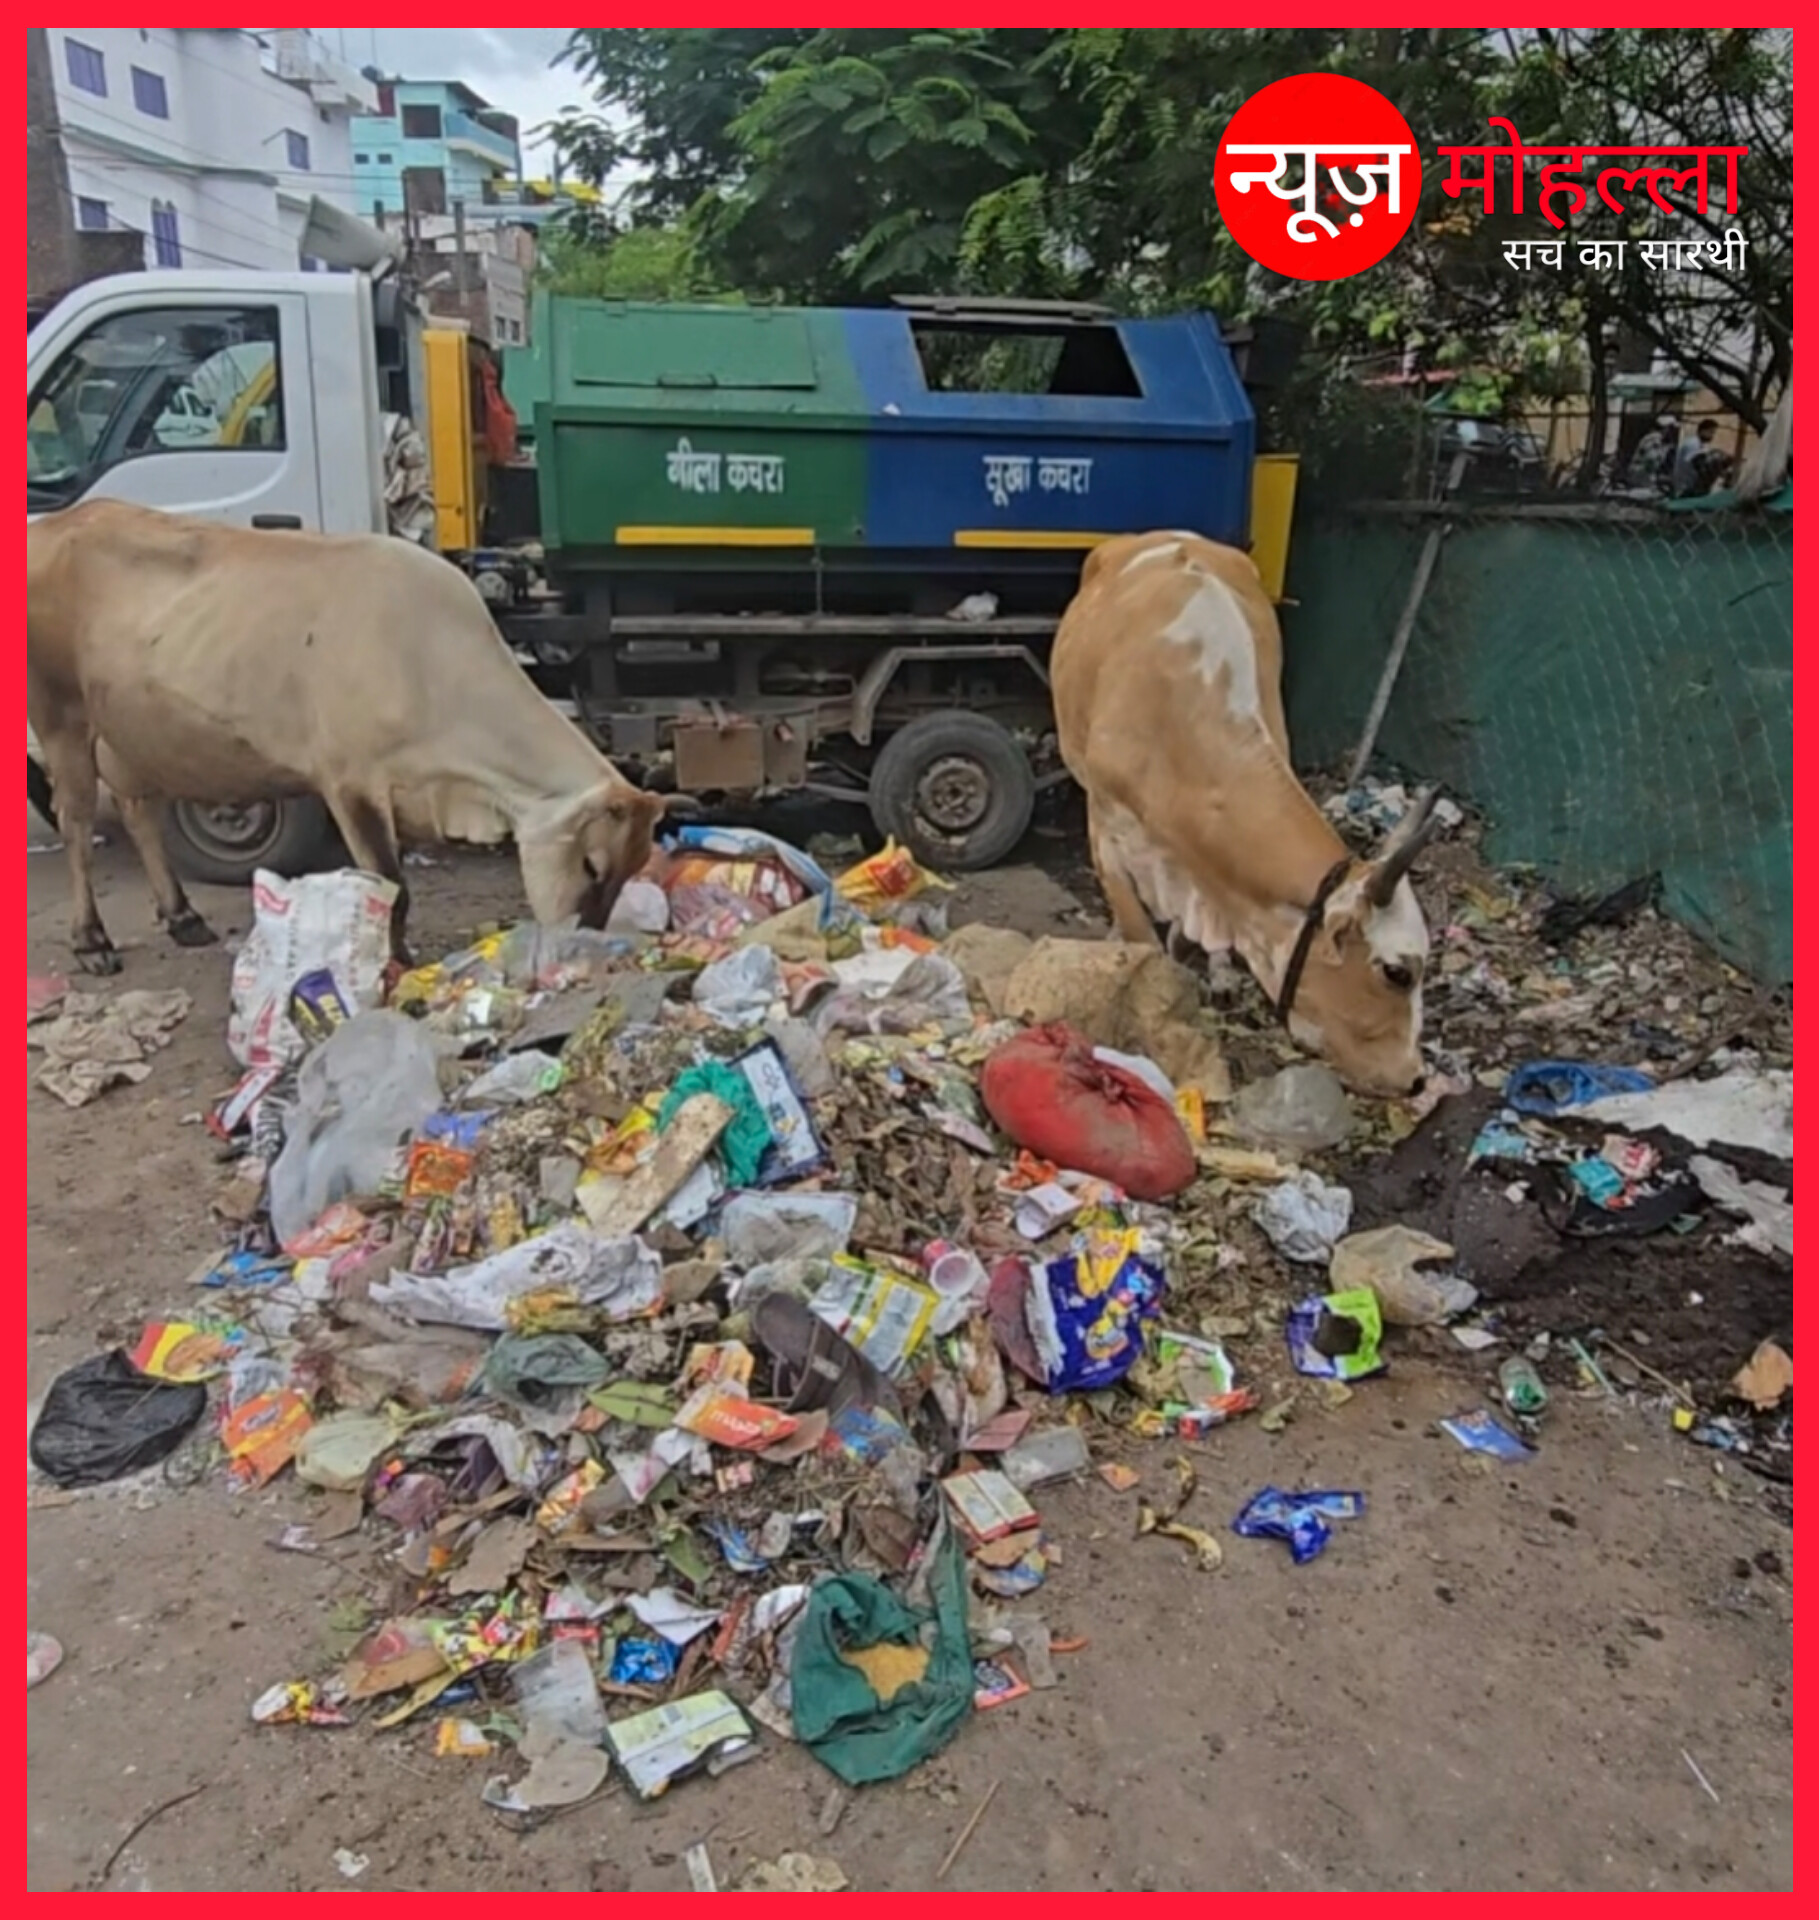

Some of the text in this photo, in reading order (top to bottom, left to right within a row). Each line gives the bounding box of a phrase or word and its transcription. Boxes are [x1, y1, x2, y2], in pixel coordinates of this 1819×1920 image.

[726, 453, 785, 494] कचरा
[983, 454, 1093, 507] सूखा कचरा
